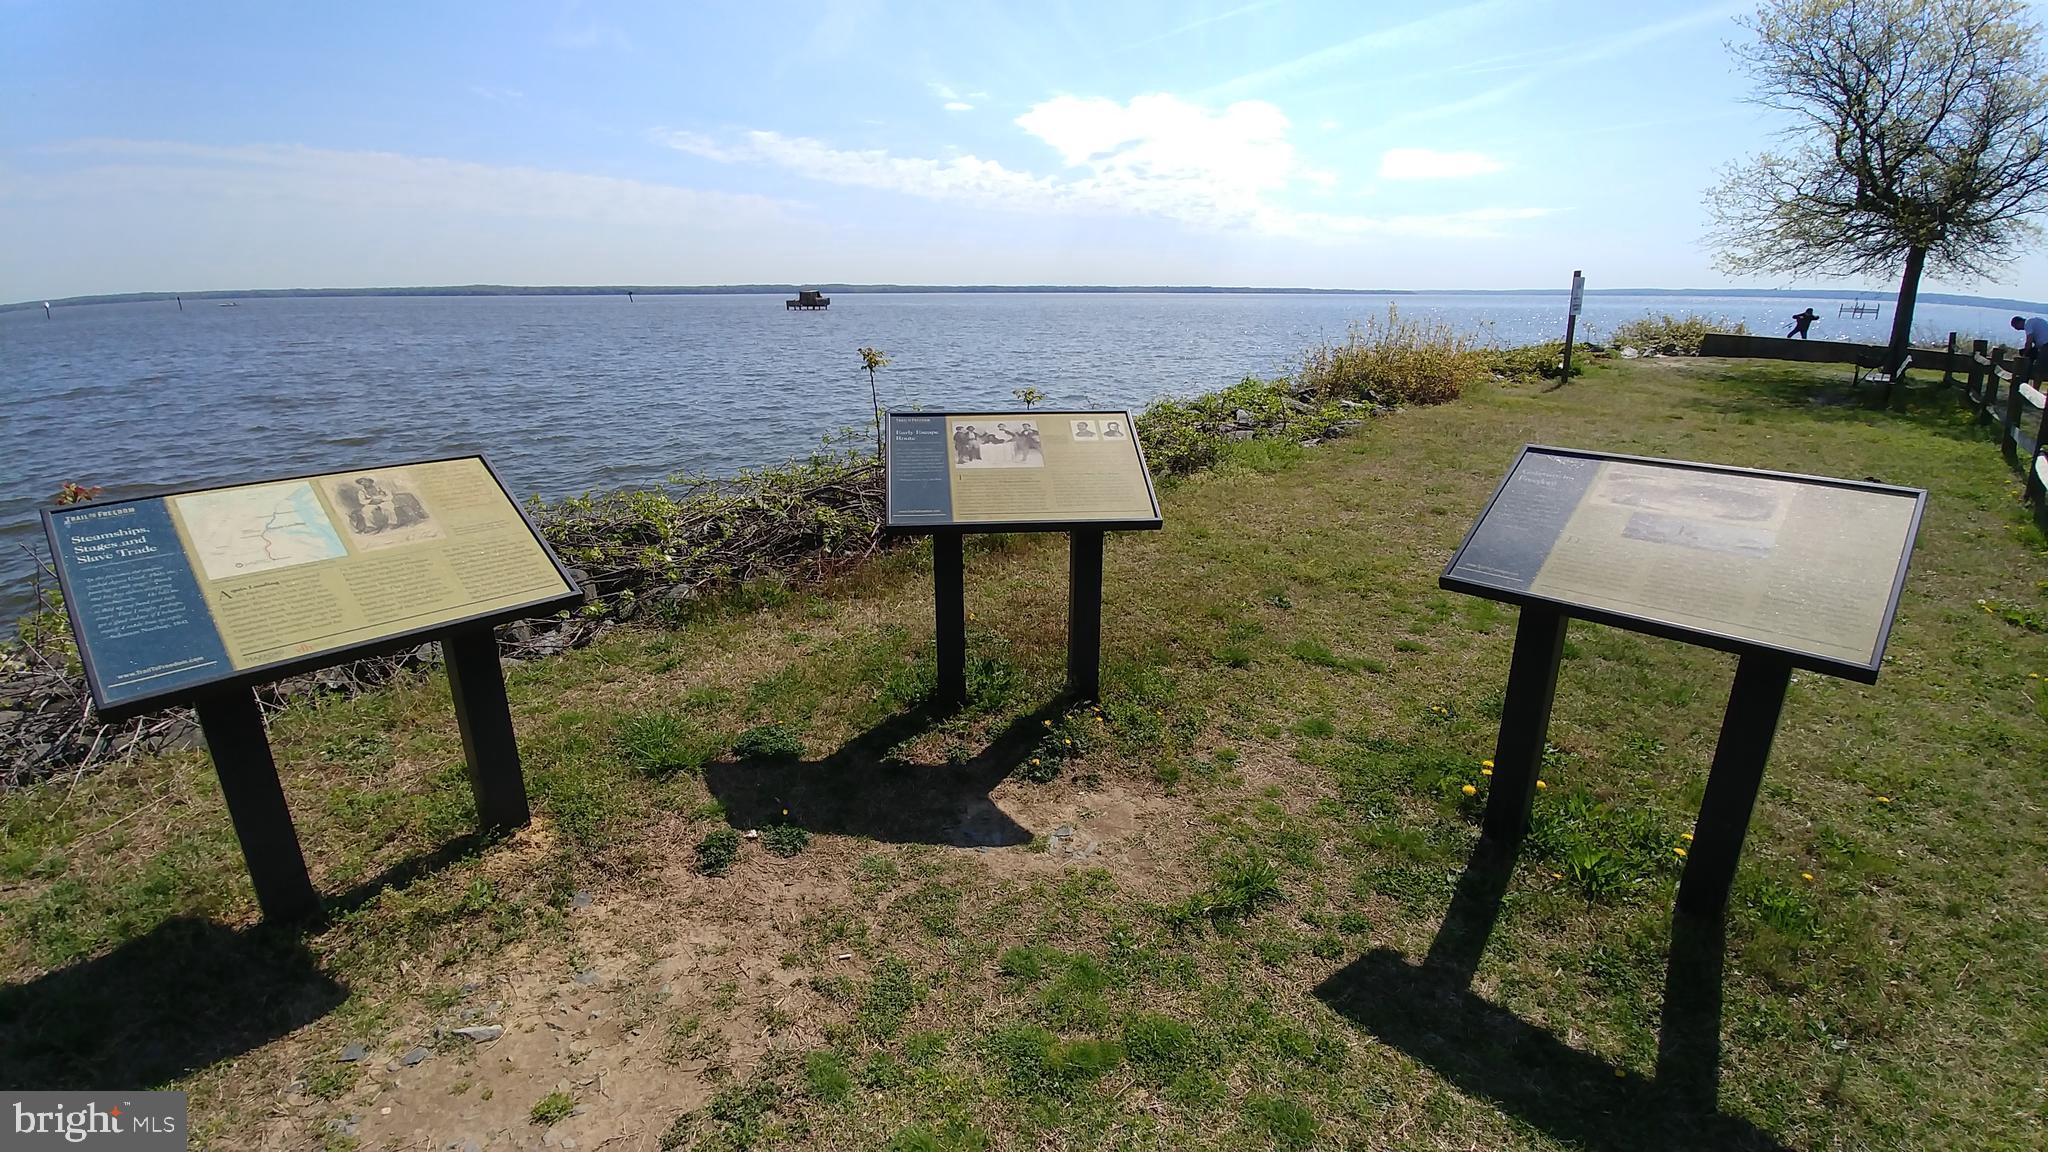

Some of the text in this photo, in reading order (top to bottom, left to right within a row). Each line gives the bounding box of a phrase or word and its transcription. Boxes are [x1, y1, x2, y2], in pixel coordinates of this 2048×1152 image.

[97, 507, 135, 518] FREEDOM
[74, 536, 147, 554] Stages and
[77, 545, 158, 564] Slave Trade
